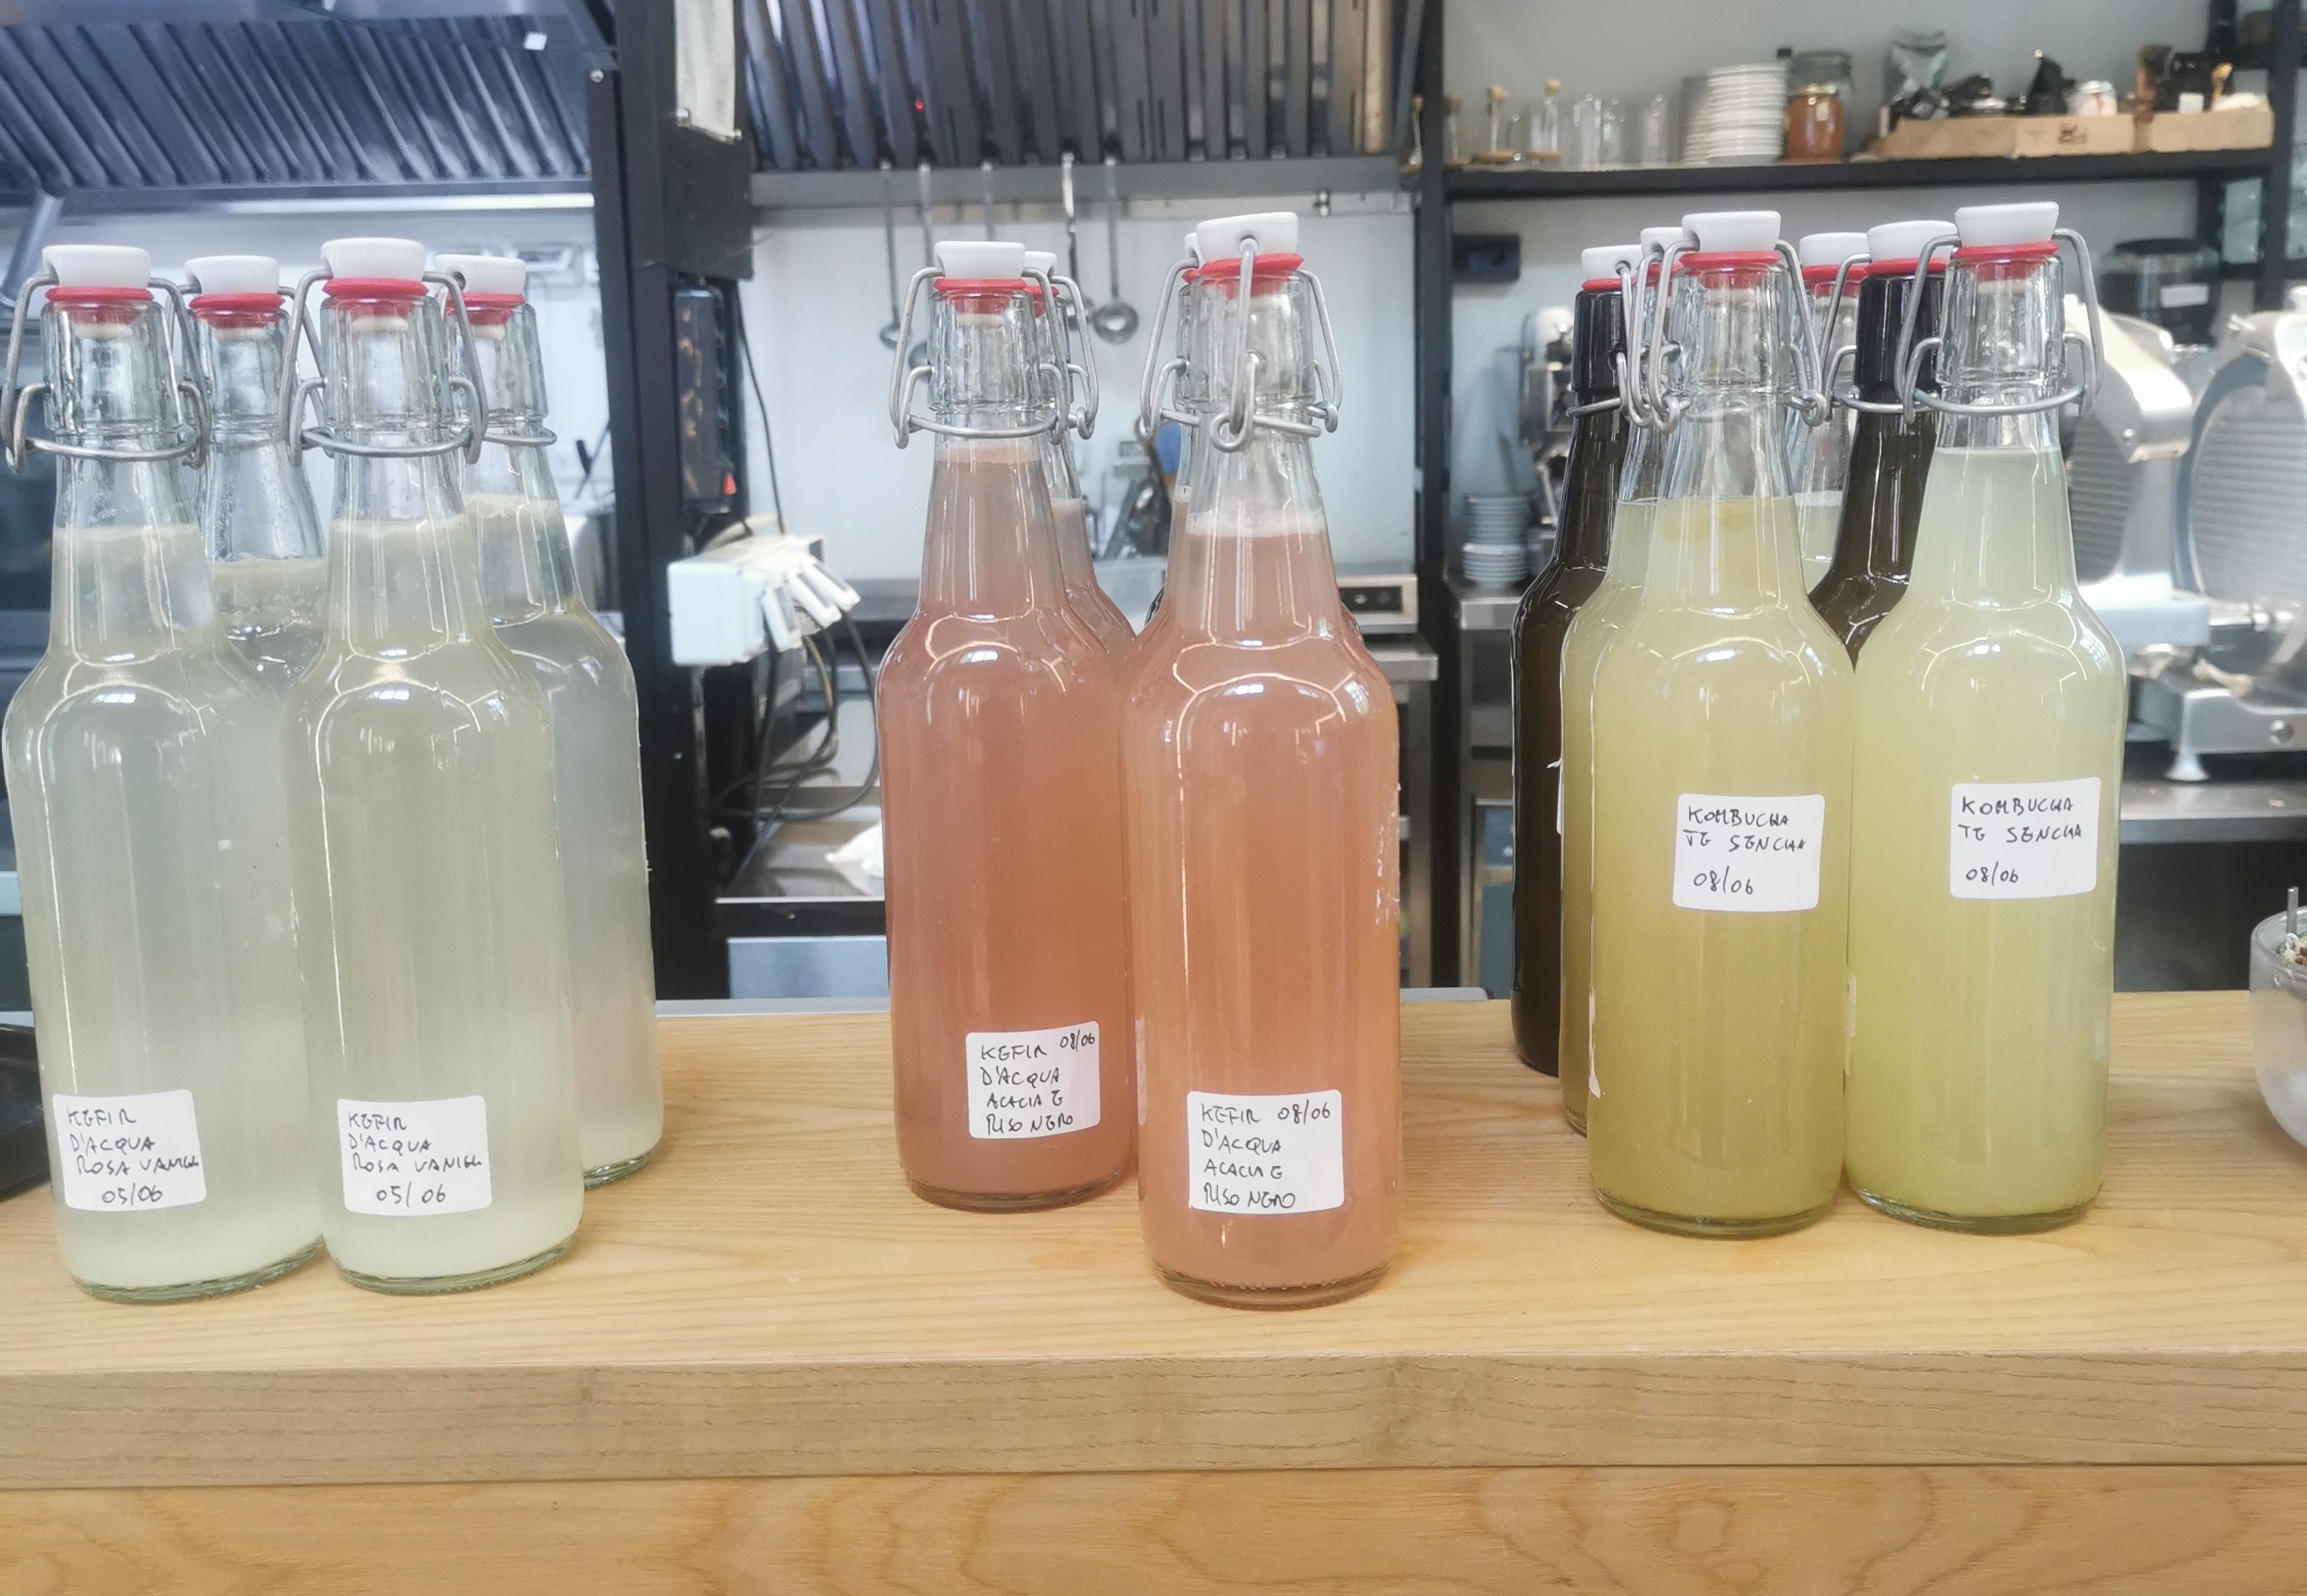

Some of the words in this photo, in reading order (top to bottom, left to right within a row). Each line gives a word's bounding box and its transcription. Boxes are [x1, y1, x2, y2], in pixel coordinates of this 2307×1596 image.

[1689, 805, 1789, 827] KOMBUCHA
[1962, 796, 2073, 817] KOMBUCHA
[2006, 823, 2082, 843] SENCHA
[1729, 836, 1806, 853] SENCHA
[1693, 865, 1754, 895] 08/06
[1966, 861, 2019, 887] 08/06
[981, 1045, 1047, 1061] KEFIR
[1060, 1029, 1095, 1052] 08/06
[980, 1066, 1059, 1088] D'ACQUA
[987, 1093, 1042, 1109] ACACIA
[1202, 1103, 1261, 1125] KEFIR
[1277, 1099, 1331, 1125] 08/06
[67, 1106, 137, 1126] KEFIR
[348, 1110, 407, 1131] KEFIR
[987, 1113, 1023, 1136] RISO
[1030, 1113, 1073, 1133] NERO
[70, 1132, 155, 1156] D'ACQUA
[348, 1133, 432, 1156] D'ACQUA
[1201, 1127, 1282, 1156] D'ACQUA
[77, 1155, 130, 1176] ROSA
[352, 1153, 399, 1173] ROSA
[1204, 1158, 1264, 1178] ACACIA
[102, 1182, 163, 1206] 05/06
[376, 1181, 446, 1207] 05/06
[1204, 1181, 1240, 1206] RISO
[1248, 1190, 1296, 1209] NERO
